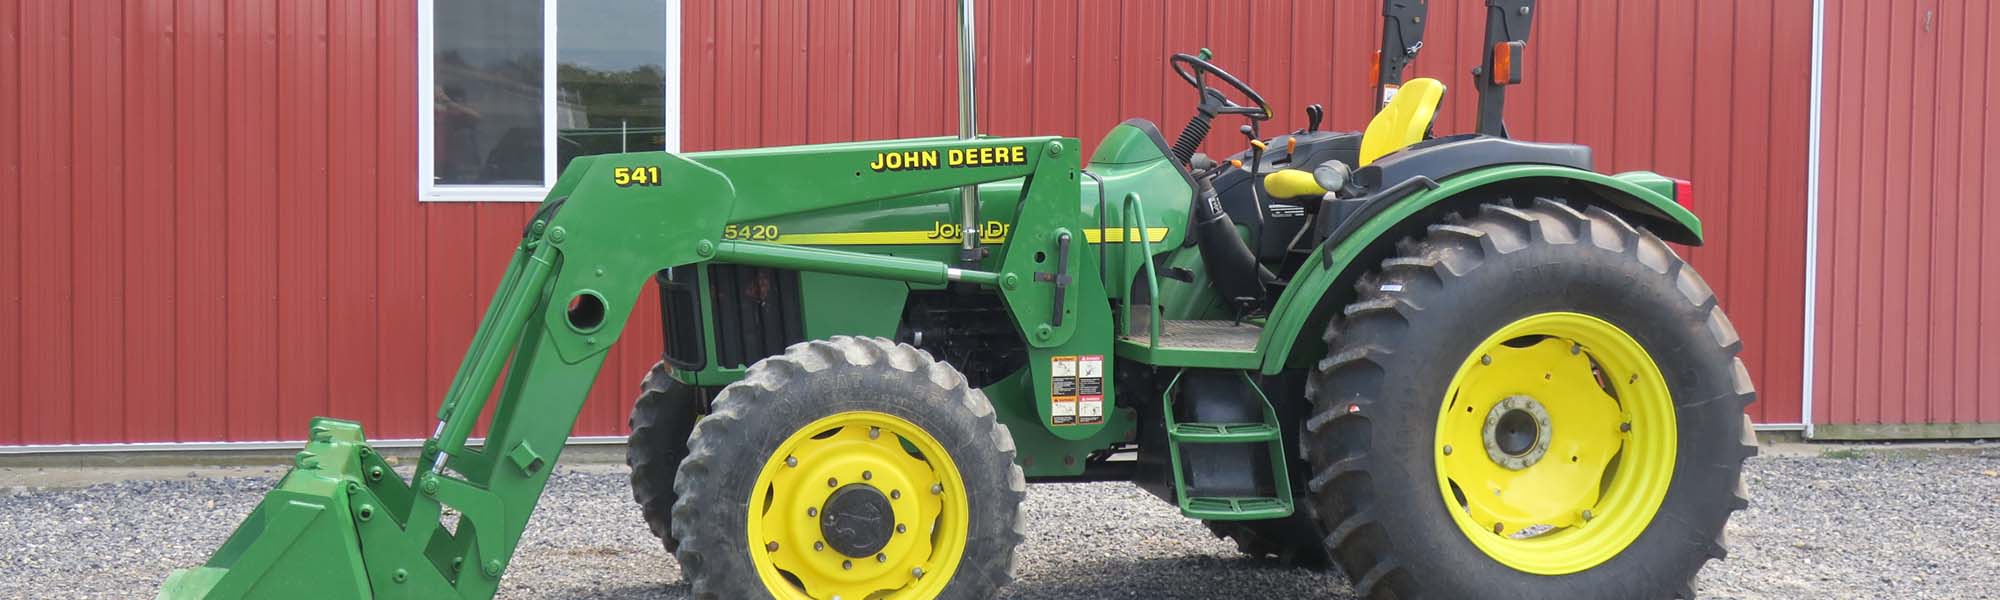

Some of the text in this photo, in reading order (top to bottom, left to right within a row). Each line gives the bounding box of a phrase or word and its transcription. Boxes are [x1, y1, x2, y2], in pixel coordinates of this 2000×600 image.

[870, 146, 1027, 172] JOHN DEERE
[614, 166, 662, 187] 541
[724, 224, 779, 240] 5420
